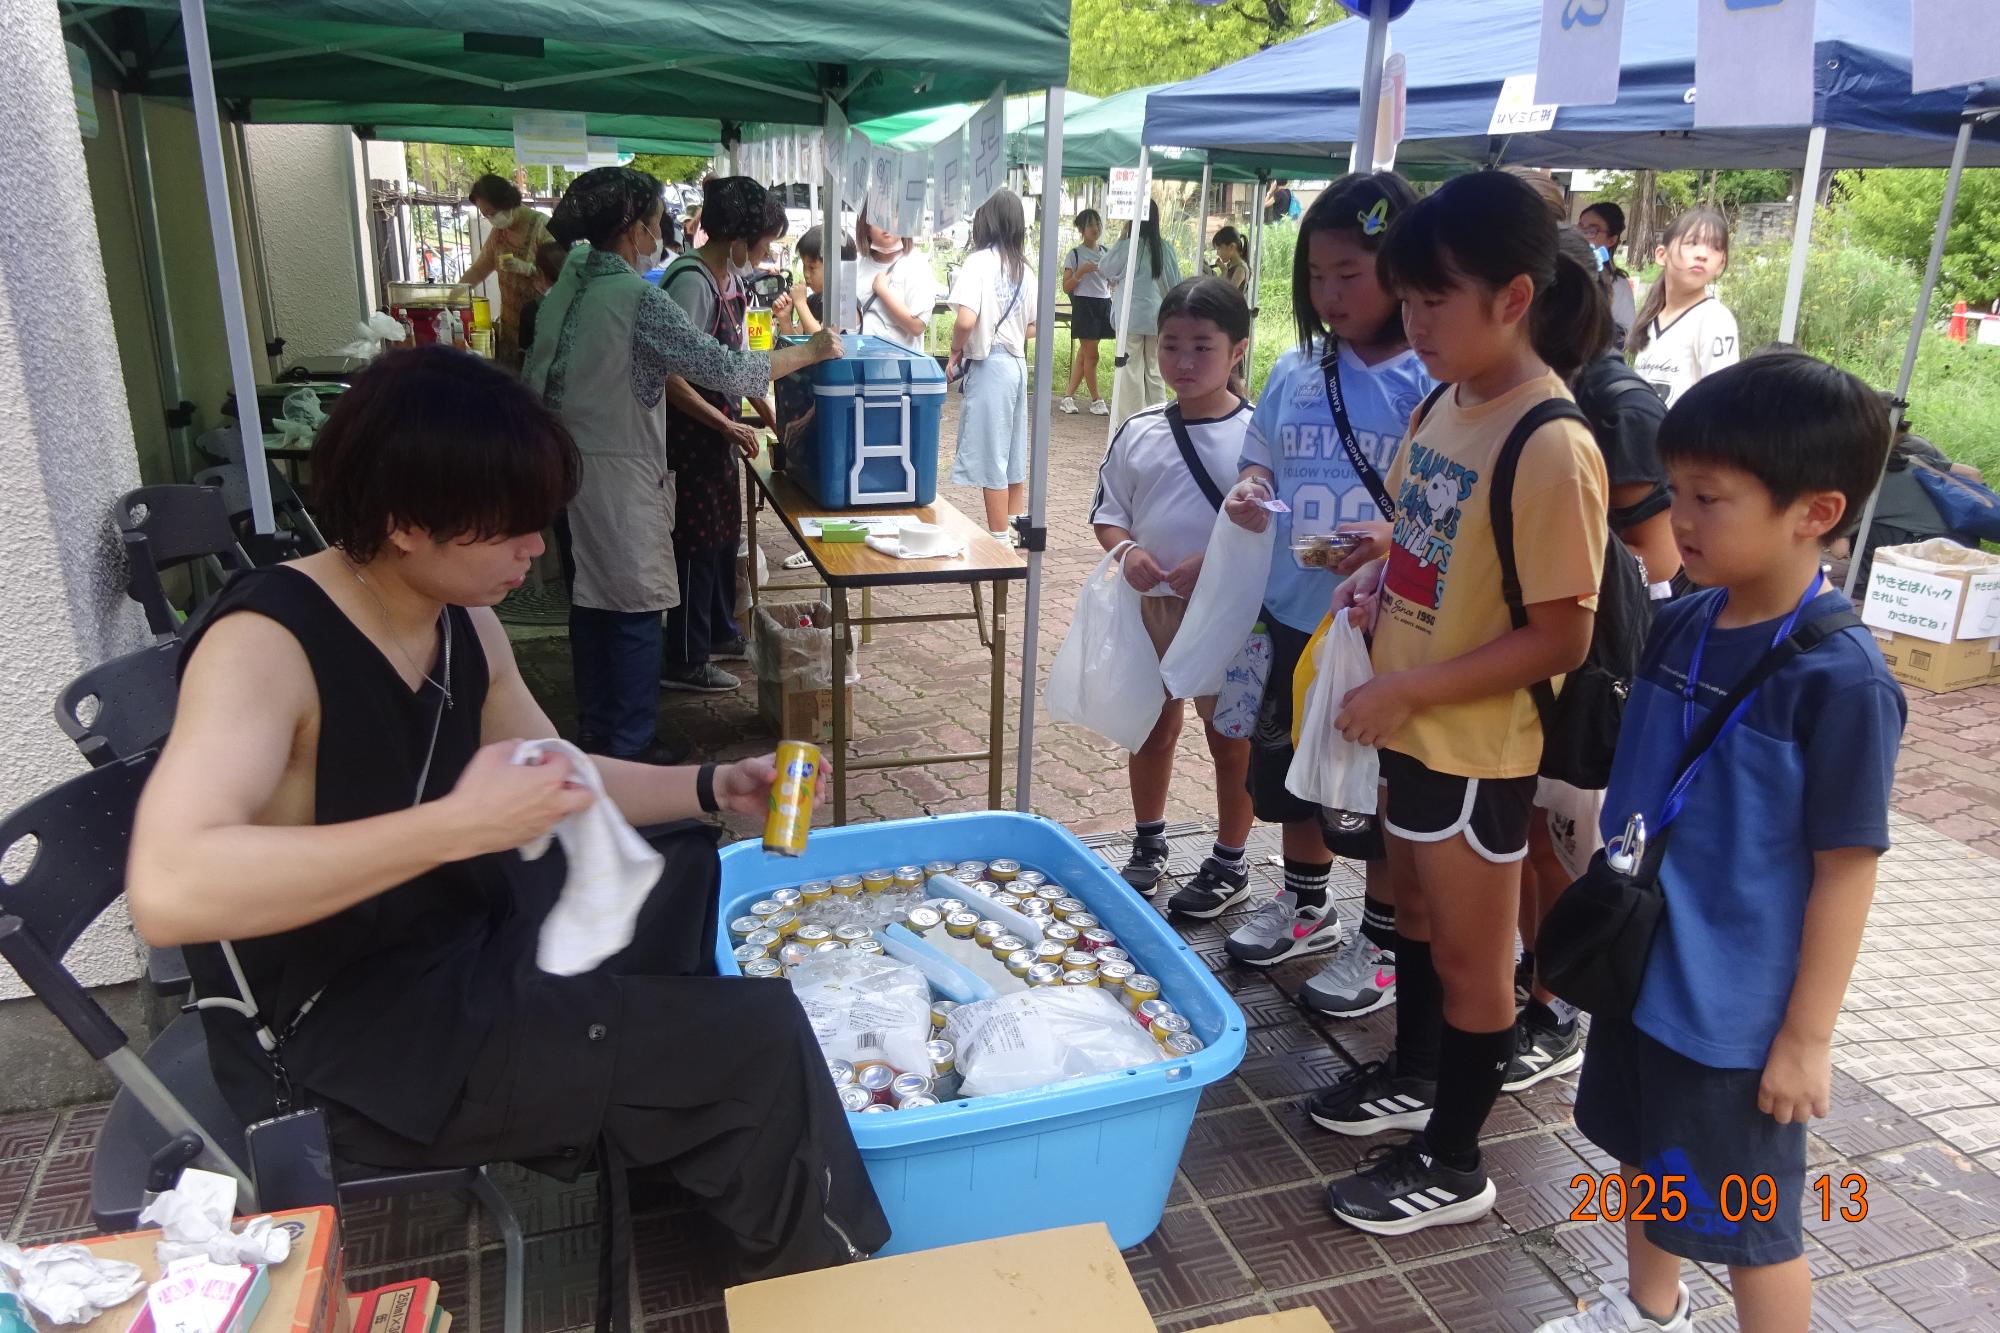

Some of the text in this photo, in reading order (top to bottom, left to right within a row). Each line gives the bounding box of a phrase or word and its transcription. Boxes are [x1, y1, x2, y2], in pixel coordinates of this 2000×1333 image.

[1329, 376, 1343, 413] KANGOL
[1345, 434, 1369, 473] KANGOL
[1377, 493, 1397, 521] NGOL
[1871, 591, 1909, 606] きれいに
[1391, 600, 1436, 626] Since 1950
